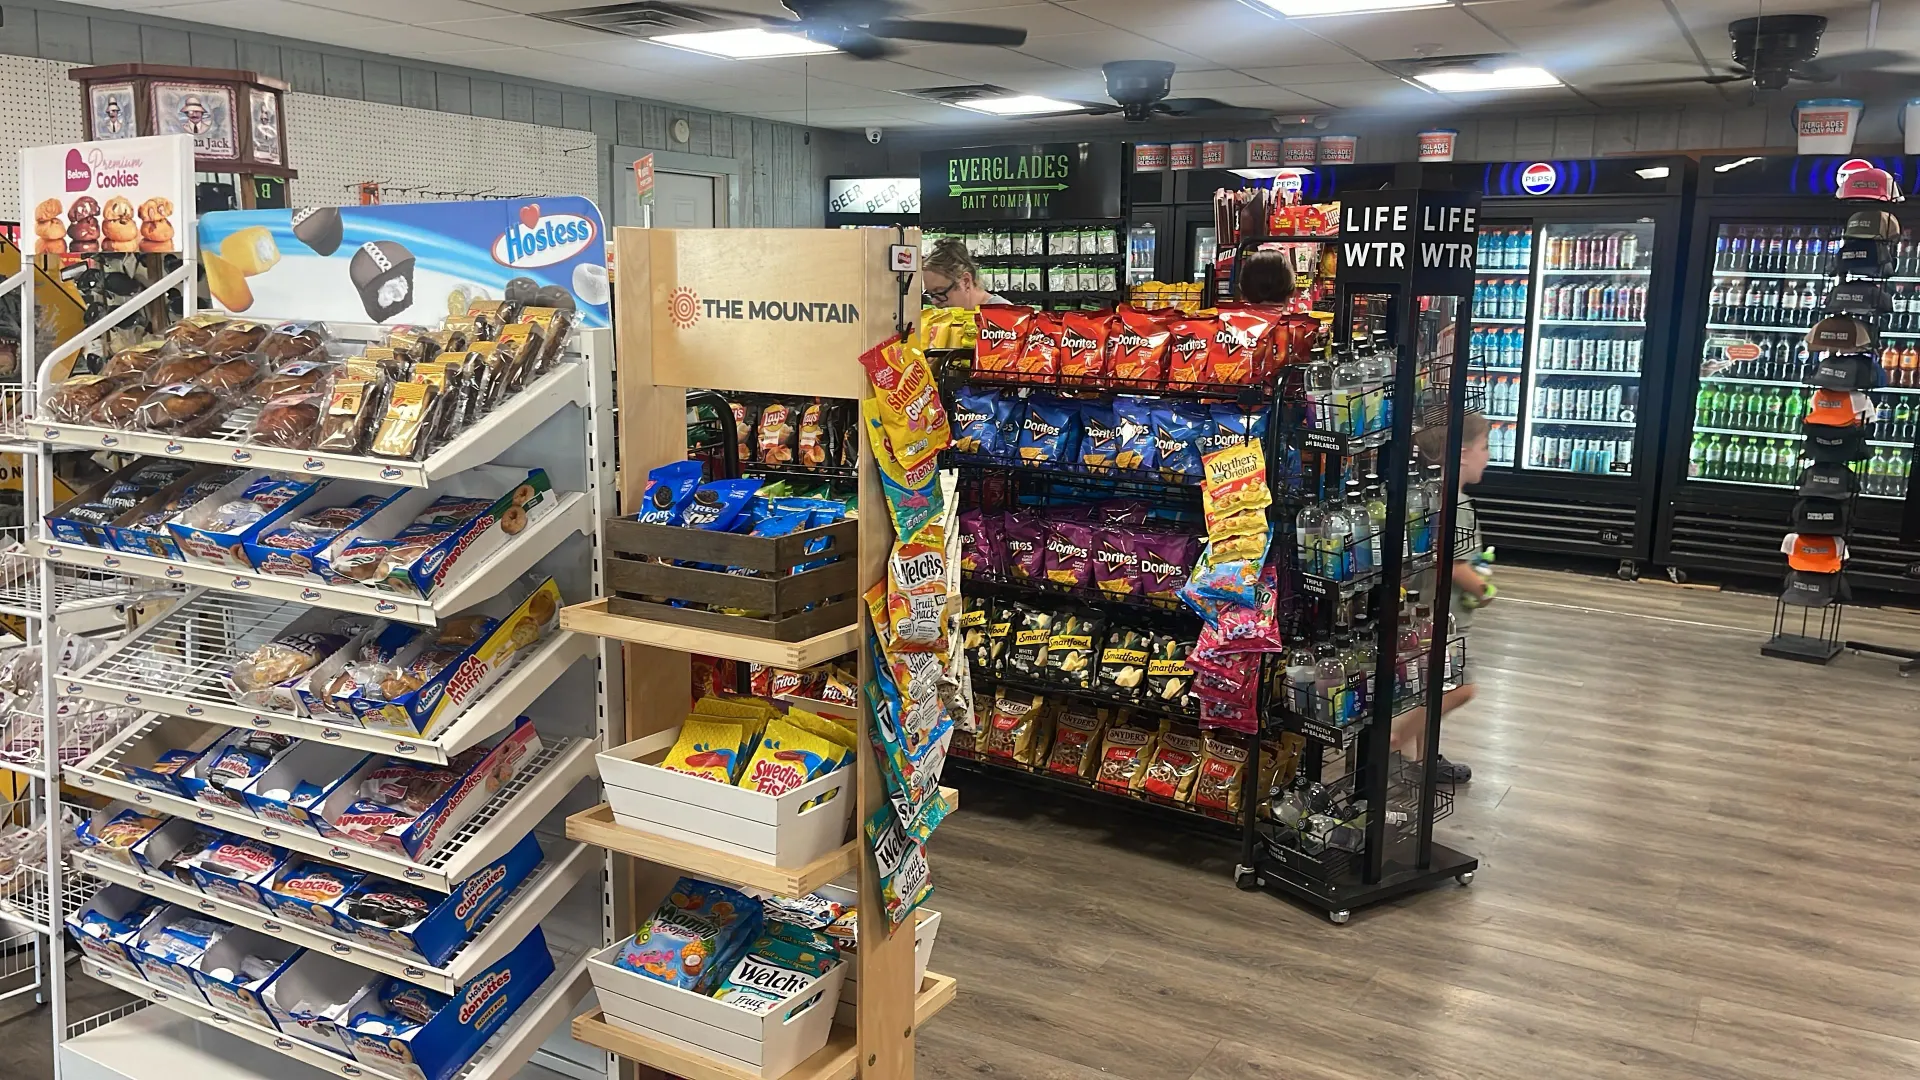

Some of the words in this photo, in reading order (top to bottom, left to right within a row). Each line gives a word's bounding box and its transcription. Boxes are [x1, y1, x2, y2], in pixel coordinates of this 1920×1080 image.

[205, 138, 229, 149] Jack
[89, 150, 143, 174] Premium
[949, 154, 1069, 182] EVERGLADES
[97, 172, 139, 188] Cookies
[1525, 173, 1554, 183] PEPSI
[831, 184, 864, 212] BEER
[866, 184, 899, 213] BEER
[900, 187, 921, 213] BEE
[962, 195, 986, 210] BAIT
[992, 193, 1050, 208] COMPANY
[1346, 206, 1408, 232] LIFE
[1425, 206, 1476, 233] LIFE
[505, 219, 589, 264] Hostess
[1344, 243, 1405, 268] WTR
[1422, 242, 1472, 269] WTR
[703, 299, 743, 319] THE
[749, 300, 859, 323] MOUNTAIN
[981, 329, 1017, 341] Doritos
[1061, 337, 1097, 349] Doritos
[1118, 334, 1152, 348] Doritos
[887, 360, 926, 413] Starburst
[1023, 418, 1060, 437] Doritos
[1308, 433, 1336, 443] PERFECTLY
[1313, 441, 1340, 451] BALANCED
[1209, 452, 1258, 475] Werther's
[1223, 462, 1258, 481] Original
[138, 471, 174, 481] MUFFINS
[906, 459, 935, 487] Friends
[113, 483, 140, 494] OREO
[103, 496, 136, 508] MUFFINS
[69, 506, 104, 520] MUFFINS
[433, 546, 462, 587] JUMBO
[455, 514, 495, 552] donettes
[1007, 540, 1033, 551] ritos
[1049, 541, 1088, 559] Doritos
[421, 550, 446, 575] Hostess
[1097, 550, 1138, 565] Doritos
[892, 553, 944, 584] Welch's
[1141, 561, 1182, 577] Doritos
[1303, 584, 1326, 595] FILTERED
[1306, 577, 1323, 588] TRIPLE
[915, 597, 935, 611] Fruit
[911, 606, 939, 622] Snacks
[1018, 632, 1050, 643] Smartfo
[1049, 637, 1088, 649] Smartfood
[1018, 648, 1033, 656] WHITE
[1103, 651, 1146, 664] Smartfood
[445, 654, 481, 698] MEGA
[1148, 662, 1190, 674] Smartfood
[451, 663, 489, 707] muffin
[417, 681, 442, 714] Hostess
[1109, 729, 1148, 744] SNYDER'S
[1304, 721, 1331, 735] PERFECTLY
[1308, 730, 1335, 743] BALANCED
[1114, 749, 1131, 757] Mini
[1167, 750, 1184, 761] Mini
[752, 760, 805, 789] Swedish
[1210, 761, 1228, 774] Mini
[422, 806, 452, 849] JUMBO
[446, 770, 483, 812] donettes
[411, 814, 435, 842] Hostess
[880, 821, 910, 870] Welc
[219, 843, 275, 868] Cupcakes
[287, 878, 342, 894] Cupcakes
[463, 870, 492, 898] Hostess
[901, 863, 926, 902] Snacks
[456, 866, 506, 919] Cupcakes
[738, 961, 809, 993] Welch's
[467, 974, 495, 1001] Hostess
[461, 970, 511, 1024] donettes
[738, 995, 765, 1009] Fruit
